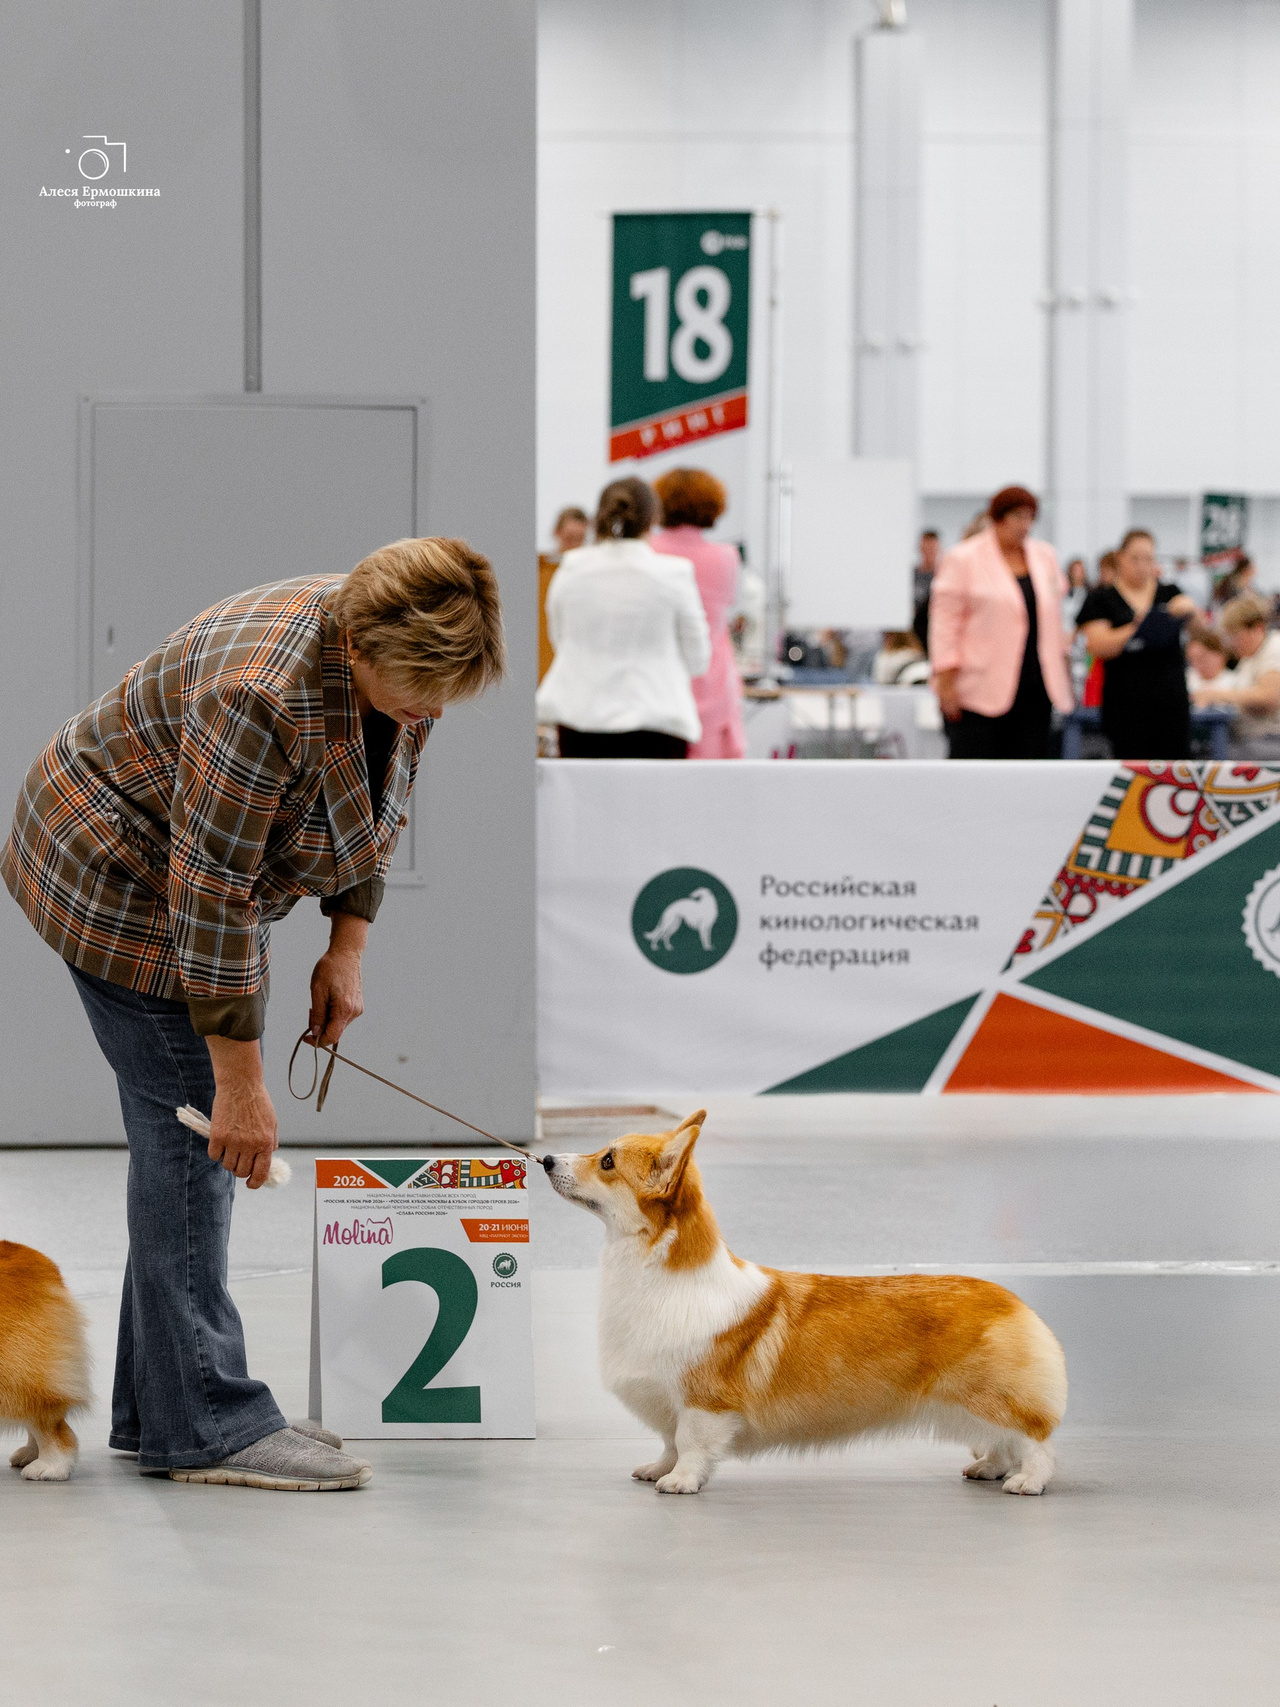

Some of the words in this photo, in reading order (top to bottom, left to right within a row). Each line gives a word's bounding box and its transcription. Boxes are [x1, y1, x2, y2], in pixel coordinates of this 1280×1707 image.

[629, 265, 733, 384] 18
[761, 874, 916, 897] Российская
[759, 914, 979, 931] кинологическая
[758, 941, 910, 972] федерация
[333, 1176, 365, 1187] 2026
[323, 1217, 394, 1245] Molina
[479, 1223, 500, 1231] 20-21
[501, 1223, 529, 1231] ИЮНЯ
[382, 1247, 481, 1423] 2
